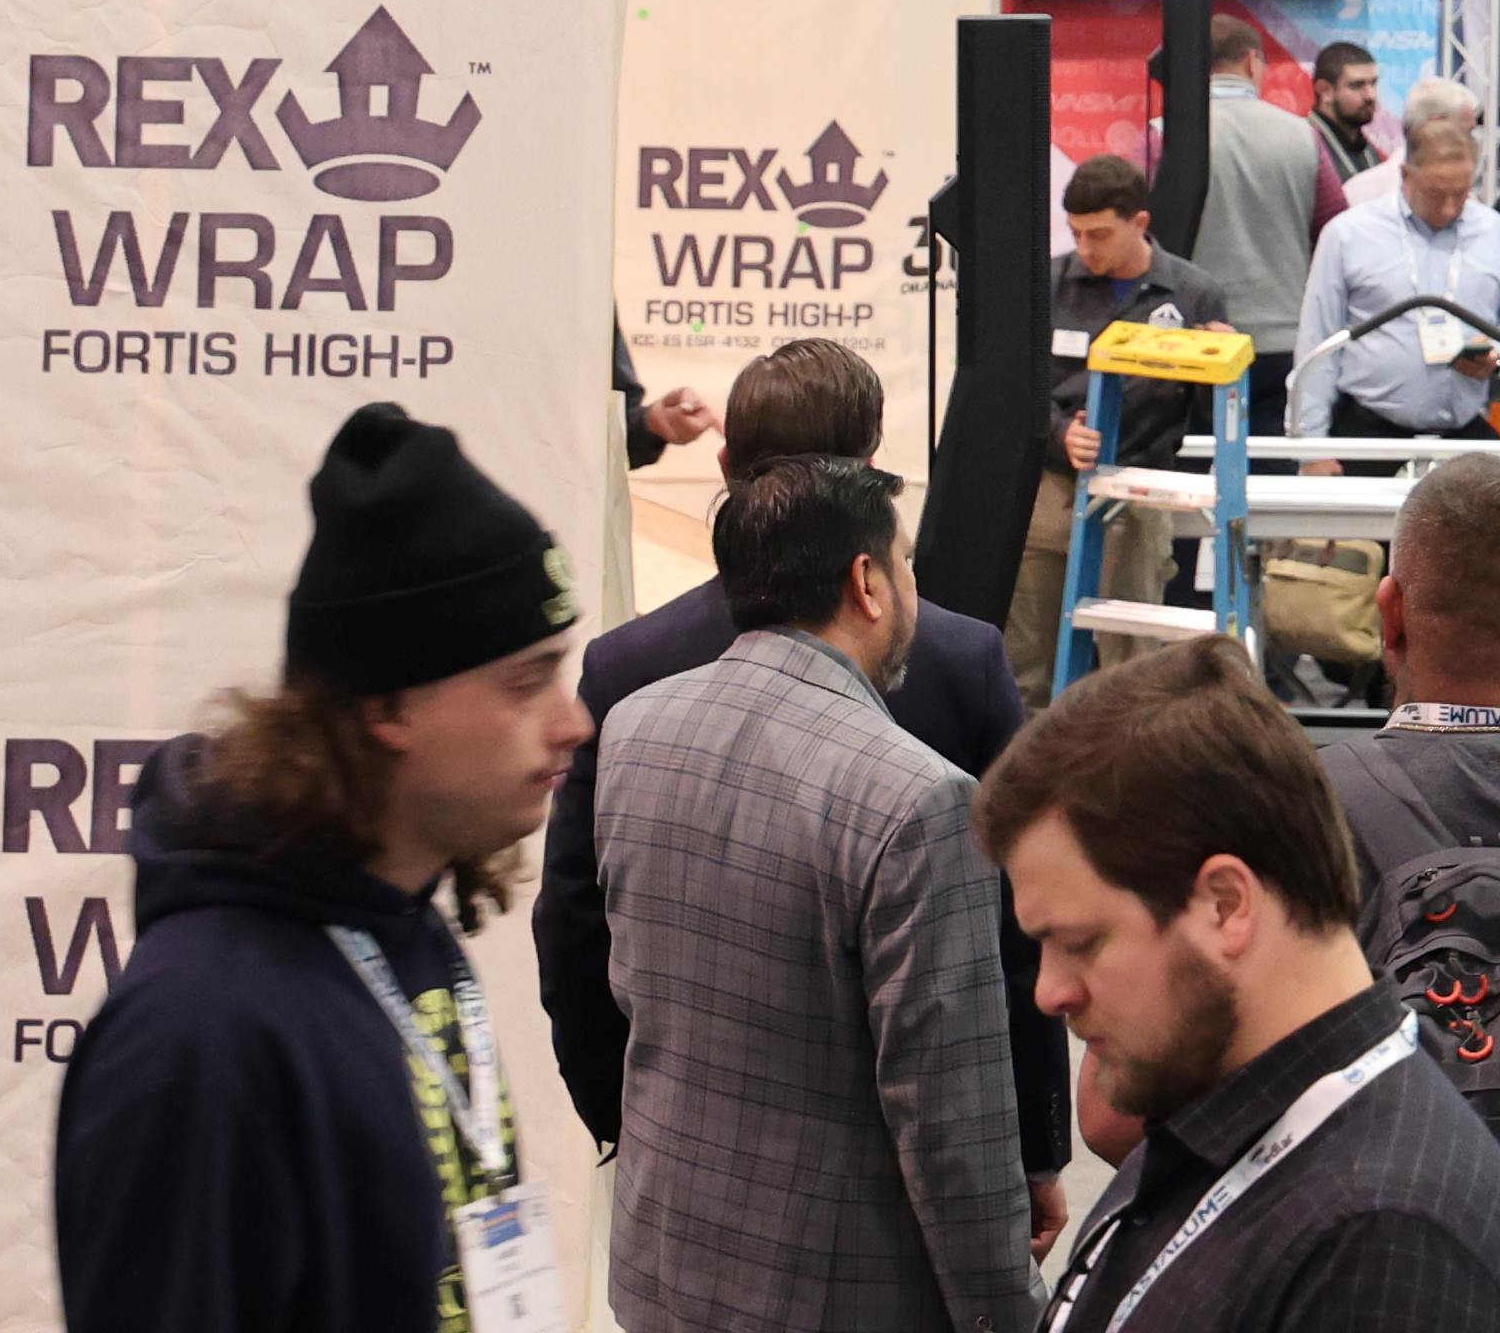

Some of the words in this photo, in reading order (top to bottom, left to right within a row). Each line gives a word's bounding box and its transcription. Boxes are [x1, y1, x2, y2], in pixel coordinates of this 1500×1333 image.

[27, 54, 284, 171] REX
[638, 146, 778, 211] REX
[51, 210, 454, 311] WRAP
[652, 233, 873, 290] WRAP
[645, 300, 754, 326] FORTIS
[768, 302, 873, 327] HIGH-P
[42, 330, 237, 376] FORTIS
[264, 333, 454, 379] HIGH-P
[2, 738, 136, 854] RE
